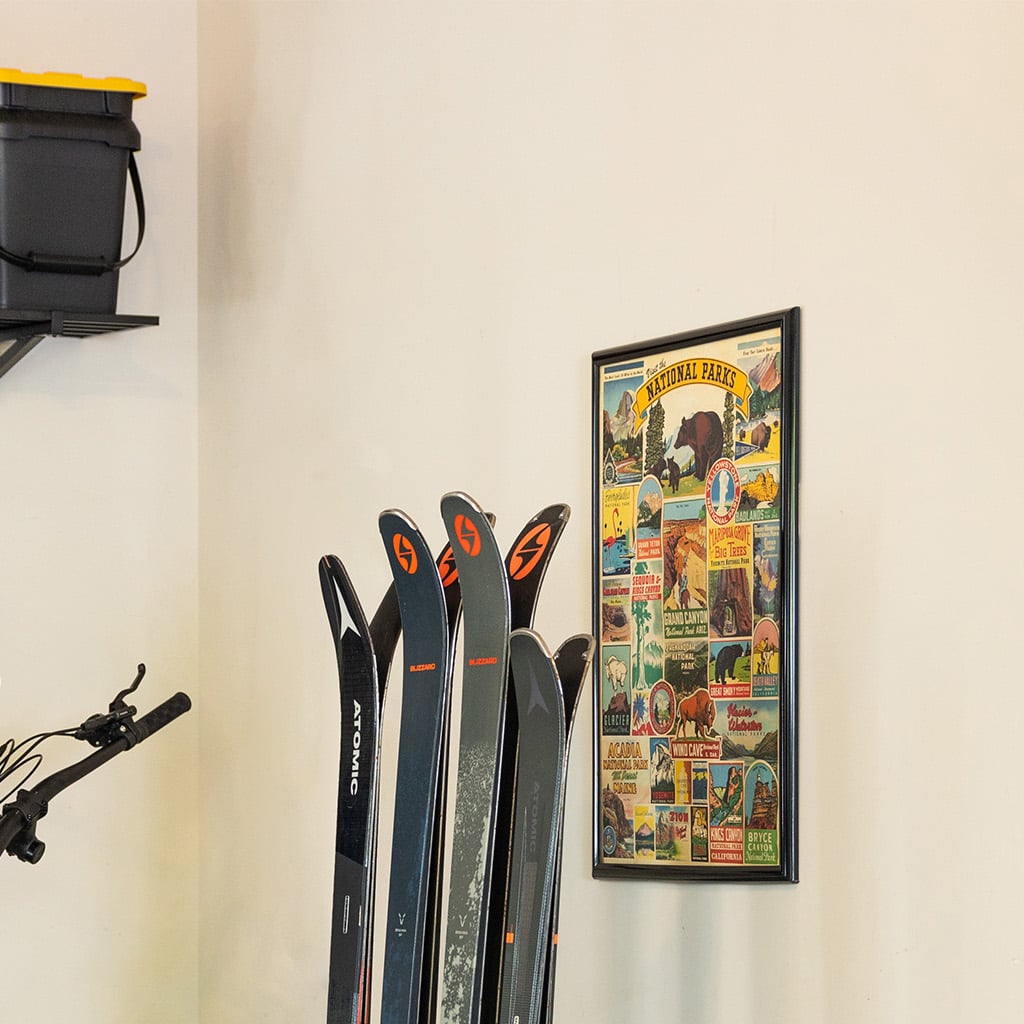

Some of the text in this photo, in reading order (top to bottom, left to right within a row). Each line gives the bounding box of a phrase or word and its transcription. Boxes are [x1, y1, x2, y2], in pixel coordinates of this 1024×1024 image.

[645, 362, 737, 402] NATIONAL PARKS
[714, 545, 727, 559] BIG
[727, 541, 748, 558] TREES
[664, 610, 709, 626] GRAND CANYON
[680, 662, 695, 670] PARK
[710, 687, 723, 697] GREAT
[604, 714, 630, 726] GLACIER
[350, 698, 362, 796] ATOMIC
[607, 741, 643, 759] ACADIA
[672, 744, 689, 757] WIND
[688, 742, 704, 757] CAVE
[603, 760, 649, 770] NATIONAL PARK
[612, 782, 637, 795] MAINE
[669, 811, 689, 822] ZION
[747, 832, 773, 843] BRYCE
[747, 843, 774, 852] CANYON
[711, 852, 743, 861] CALIFORNIA
